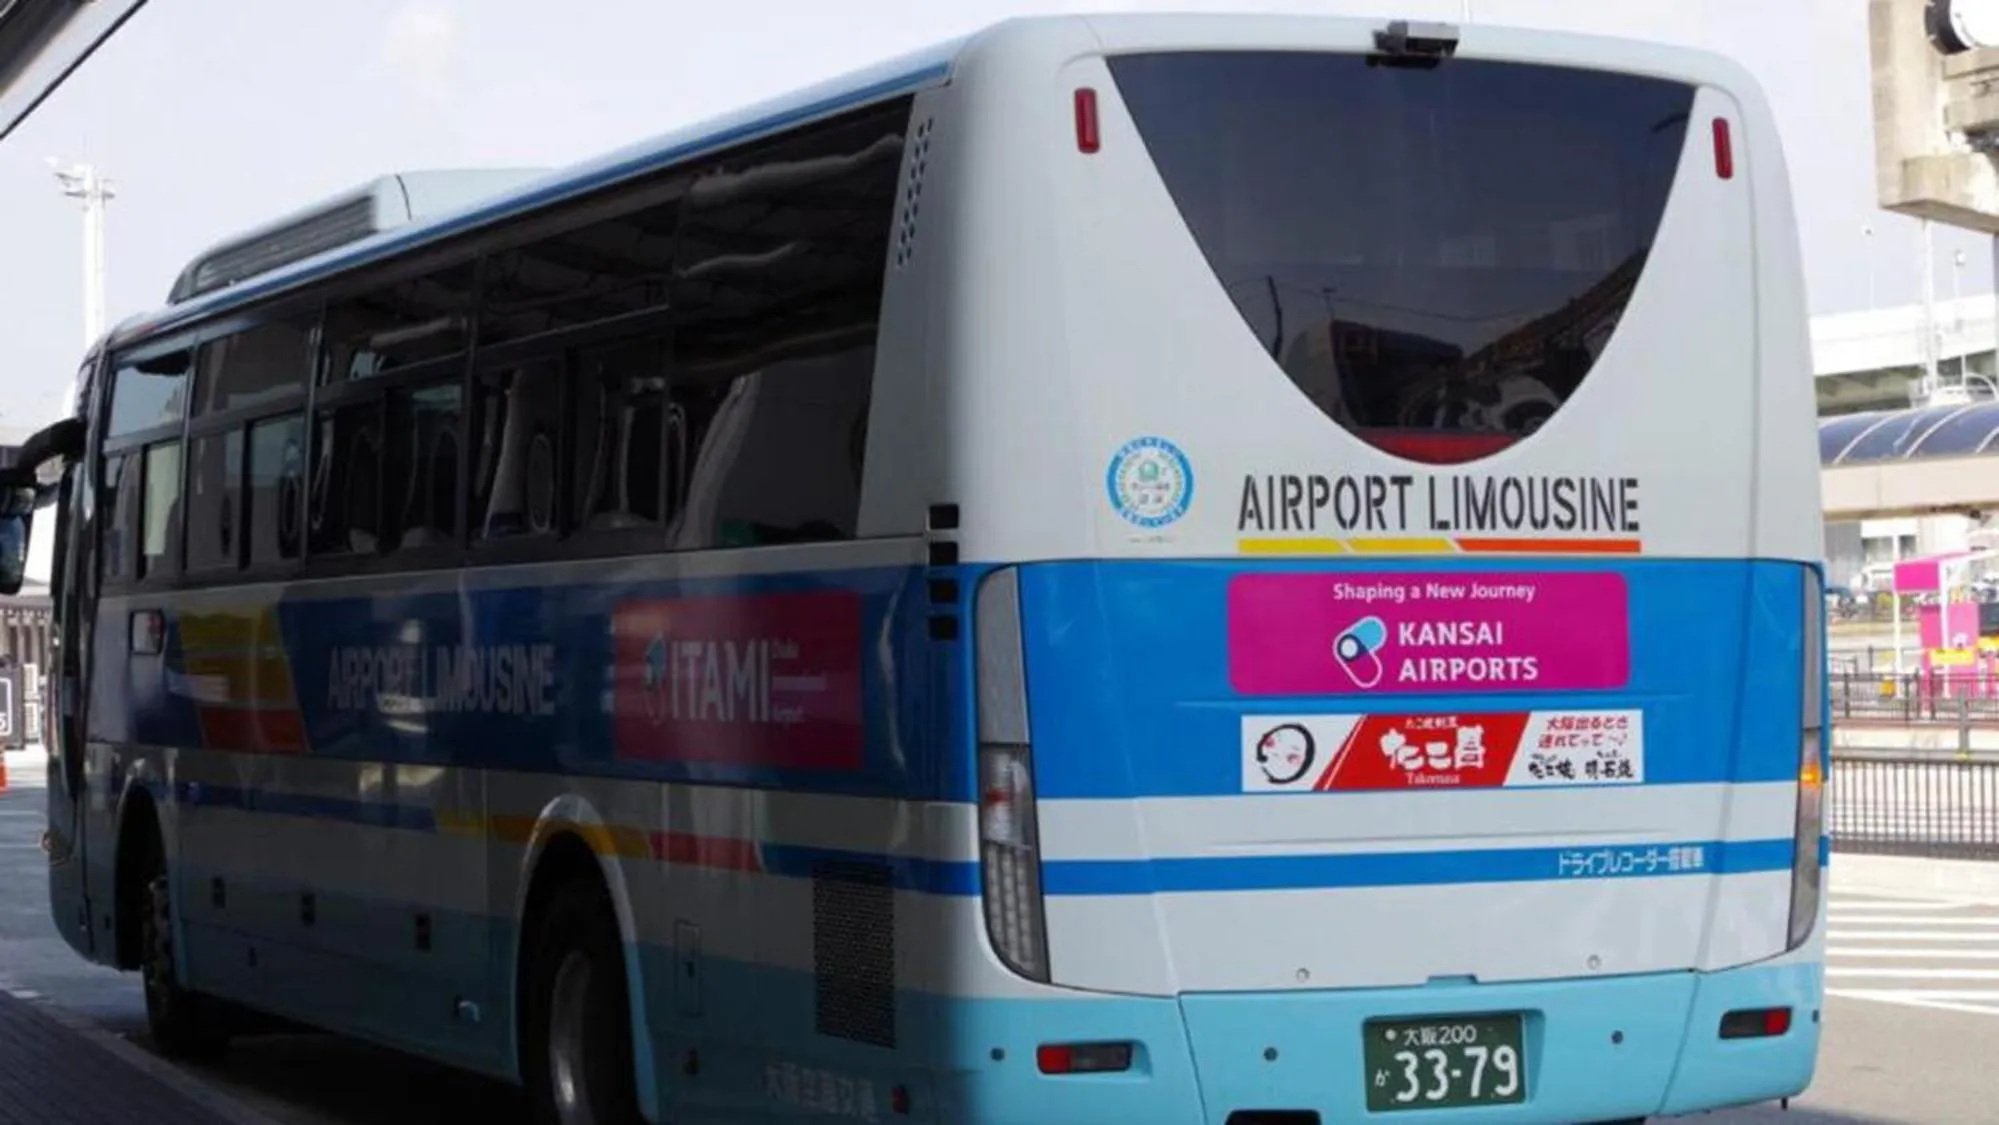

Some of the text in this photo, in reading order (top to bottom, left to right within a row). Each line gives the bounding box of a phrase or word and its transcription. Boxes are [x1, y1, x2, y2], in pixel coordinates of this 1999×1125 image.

[1238, 475, 1414, 532] AIRPORT
[1429, 476, 1640, 533] LIMOUSINE
[1333, 582, 1536, 604] Shaping a New Journey
[1399, 622, 1503, 646] KANSAI
[671, 638, 771, 722] ITAMI
[1398, 656, 1539, 682] AIRPORTS
[1379, 723, 1487, 770] たこ昌
[1374, 1044, 1519, 1102] か 33-79
